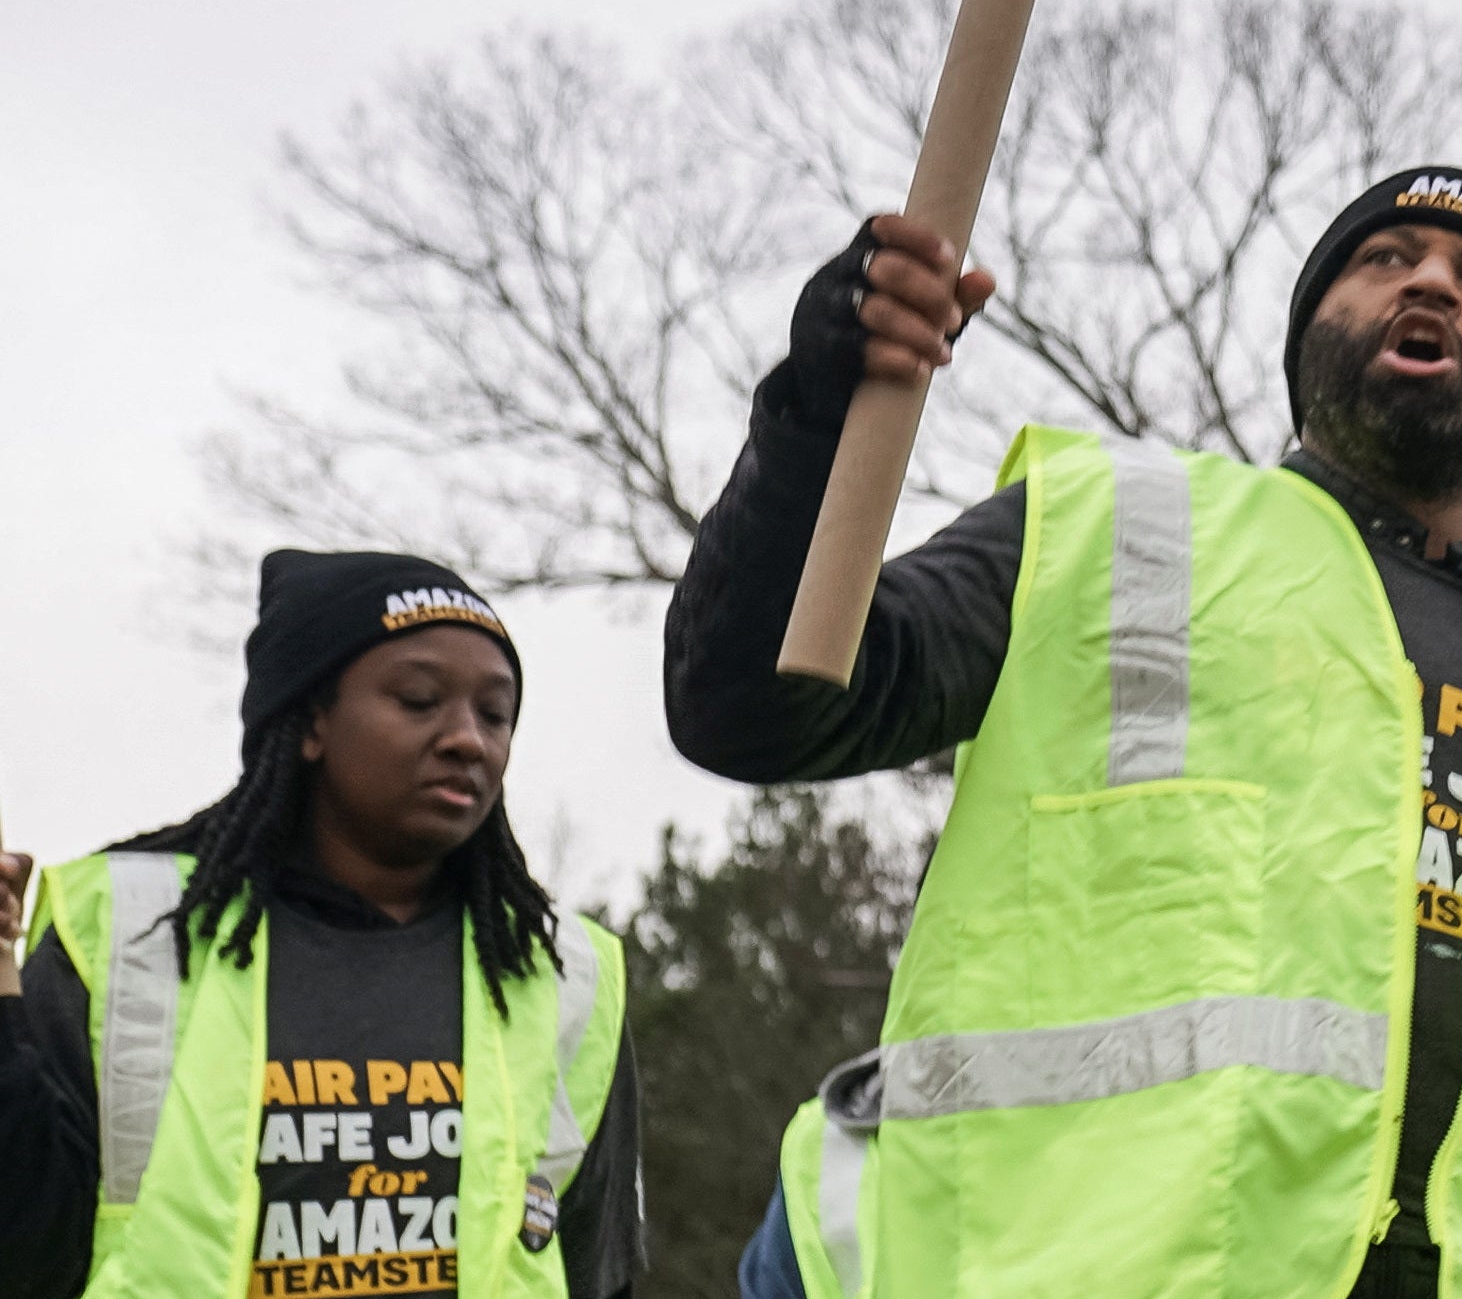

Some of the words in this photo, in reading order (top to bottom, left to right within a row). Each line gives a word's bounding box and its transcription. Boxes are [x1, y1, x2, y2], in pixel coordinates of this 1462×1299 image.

[265, 1059, 358, 1106] AIR
[259, 1112, 375, 1164] AFE
[348, 1163, 428, 1198] for
[259, 1196, 460, 1262] AMAZO
